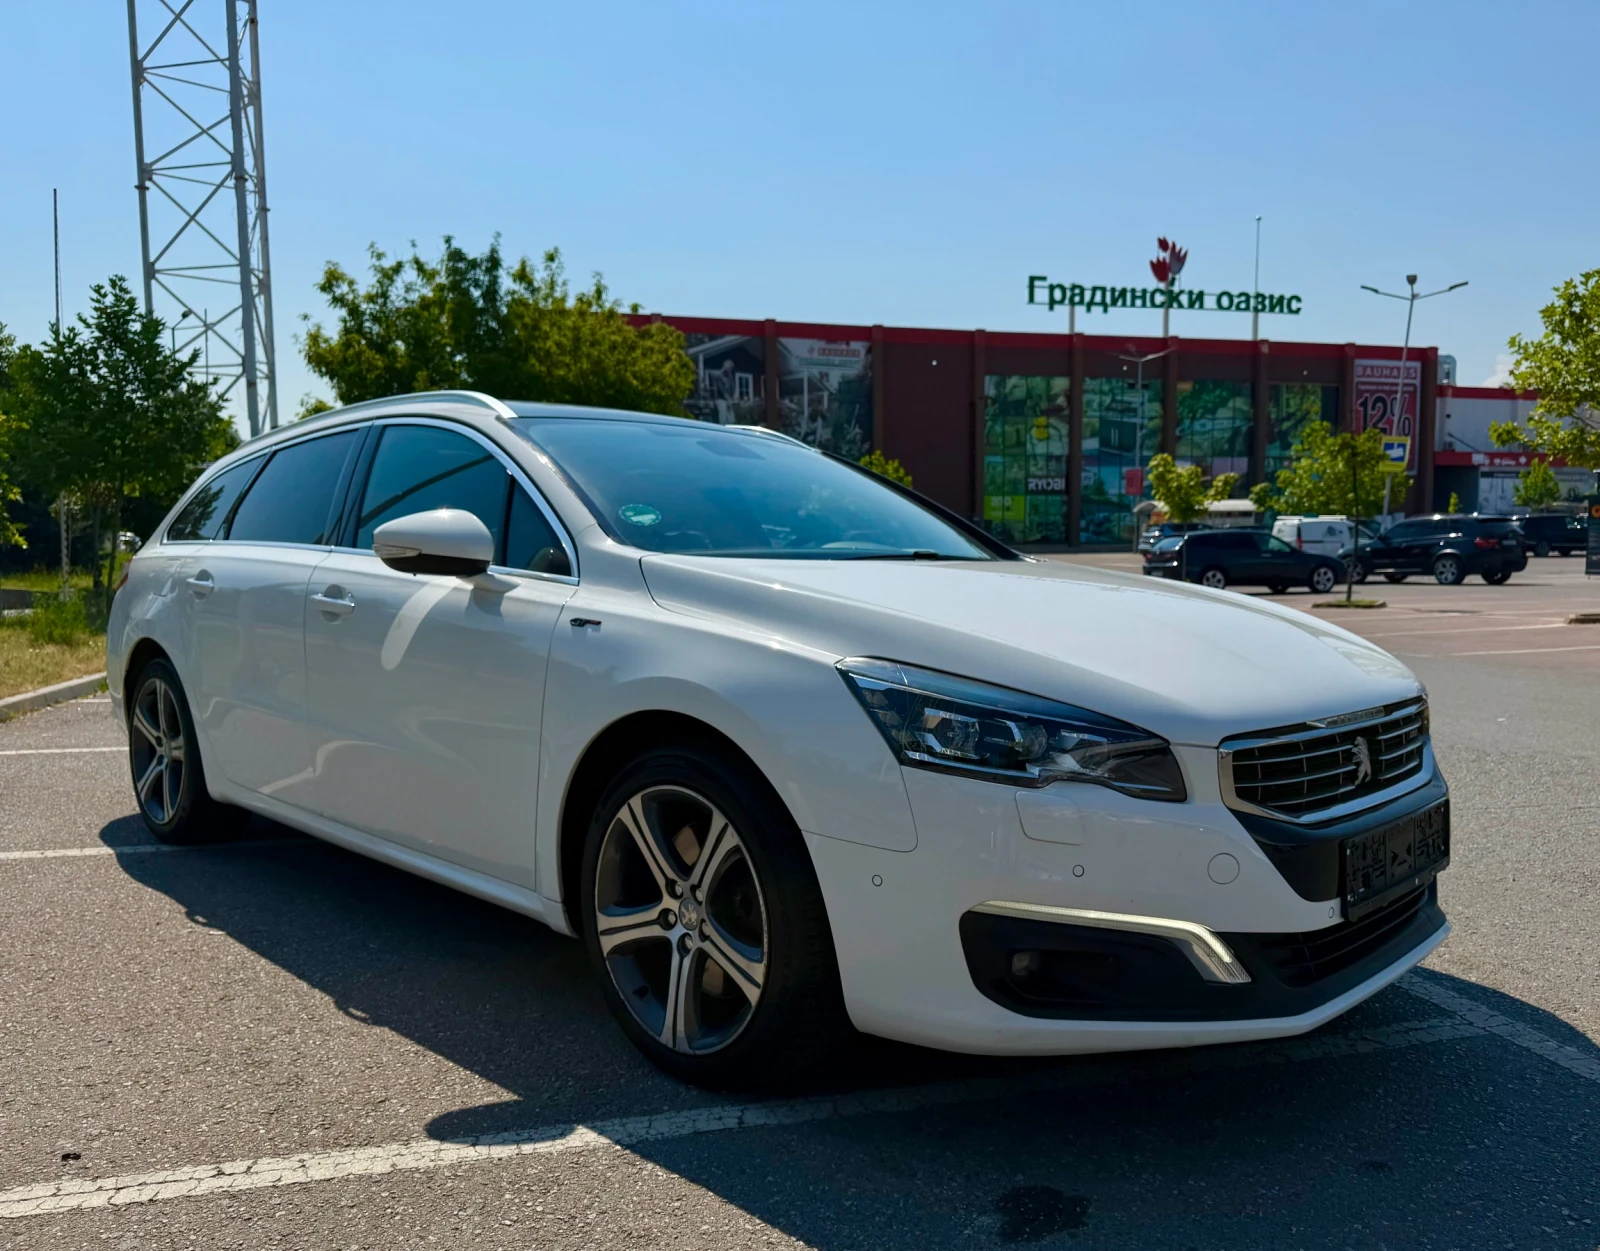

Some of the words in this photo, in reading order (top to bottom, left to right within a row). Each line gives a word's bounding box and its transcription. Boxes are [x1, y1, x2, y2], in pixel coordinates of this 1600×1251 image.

[1028, 275, 1204, 314] Градински
[1216, 290, 1302, 315] оазис
[1027, 477, 1065, 491] RYOBI
